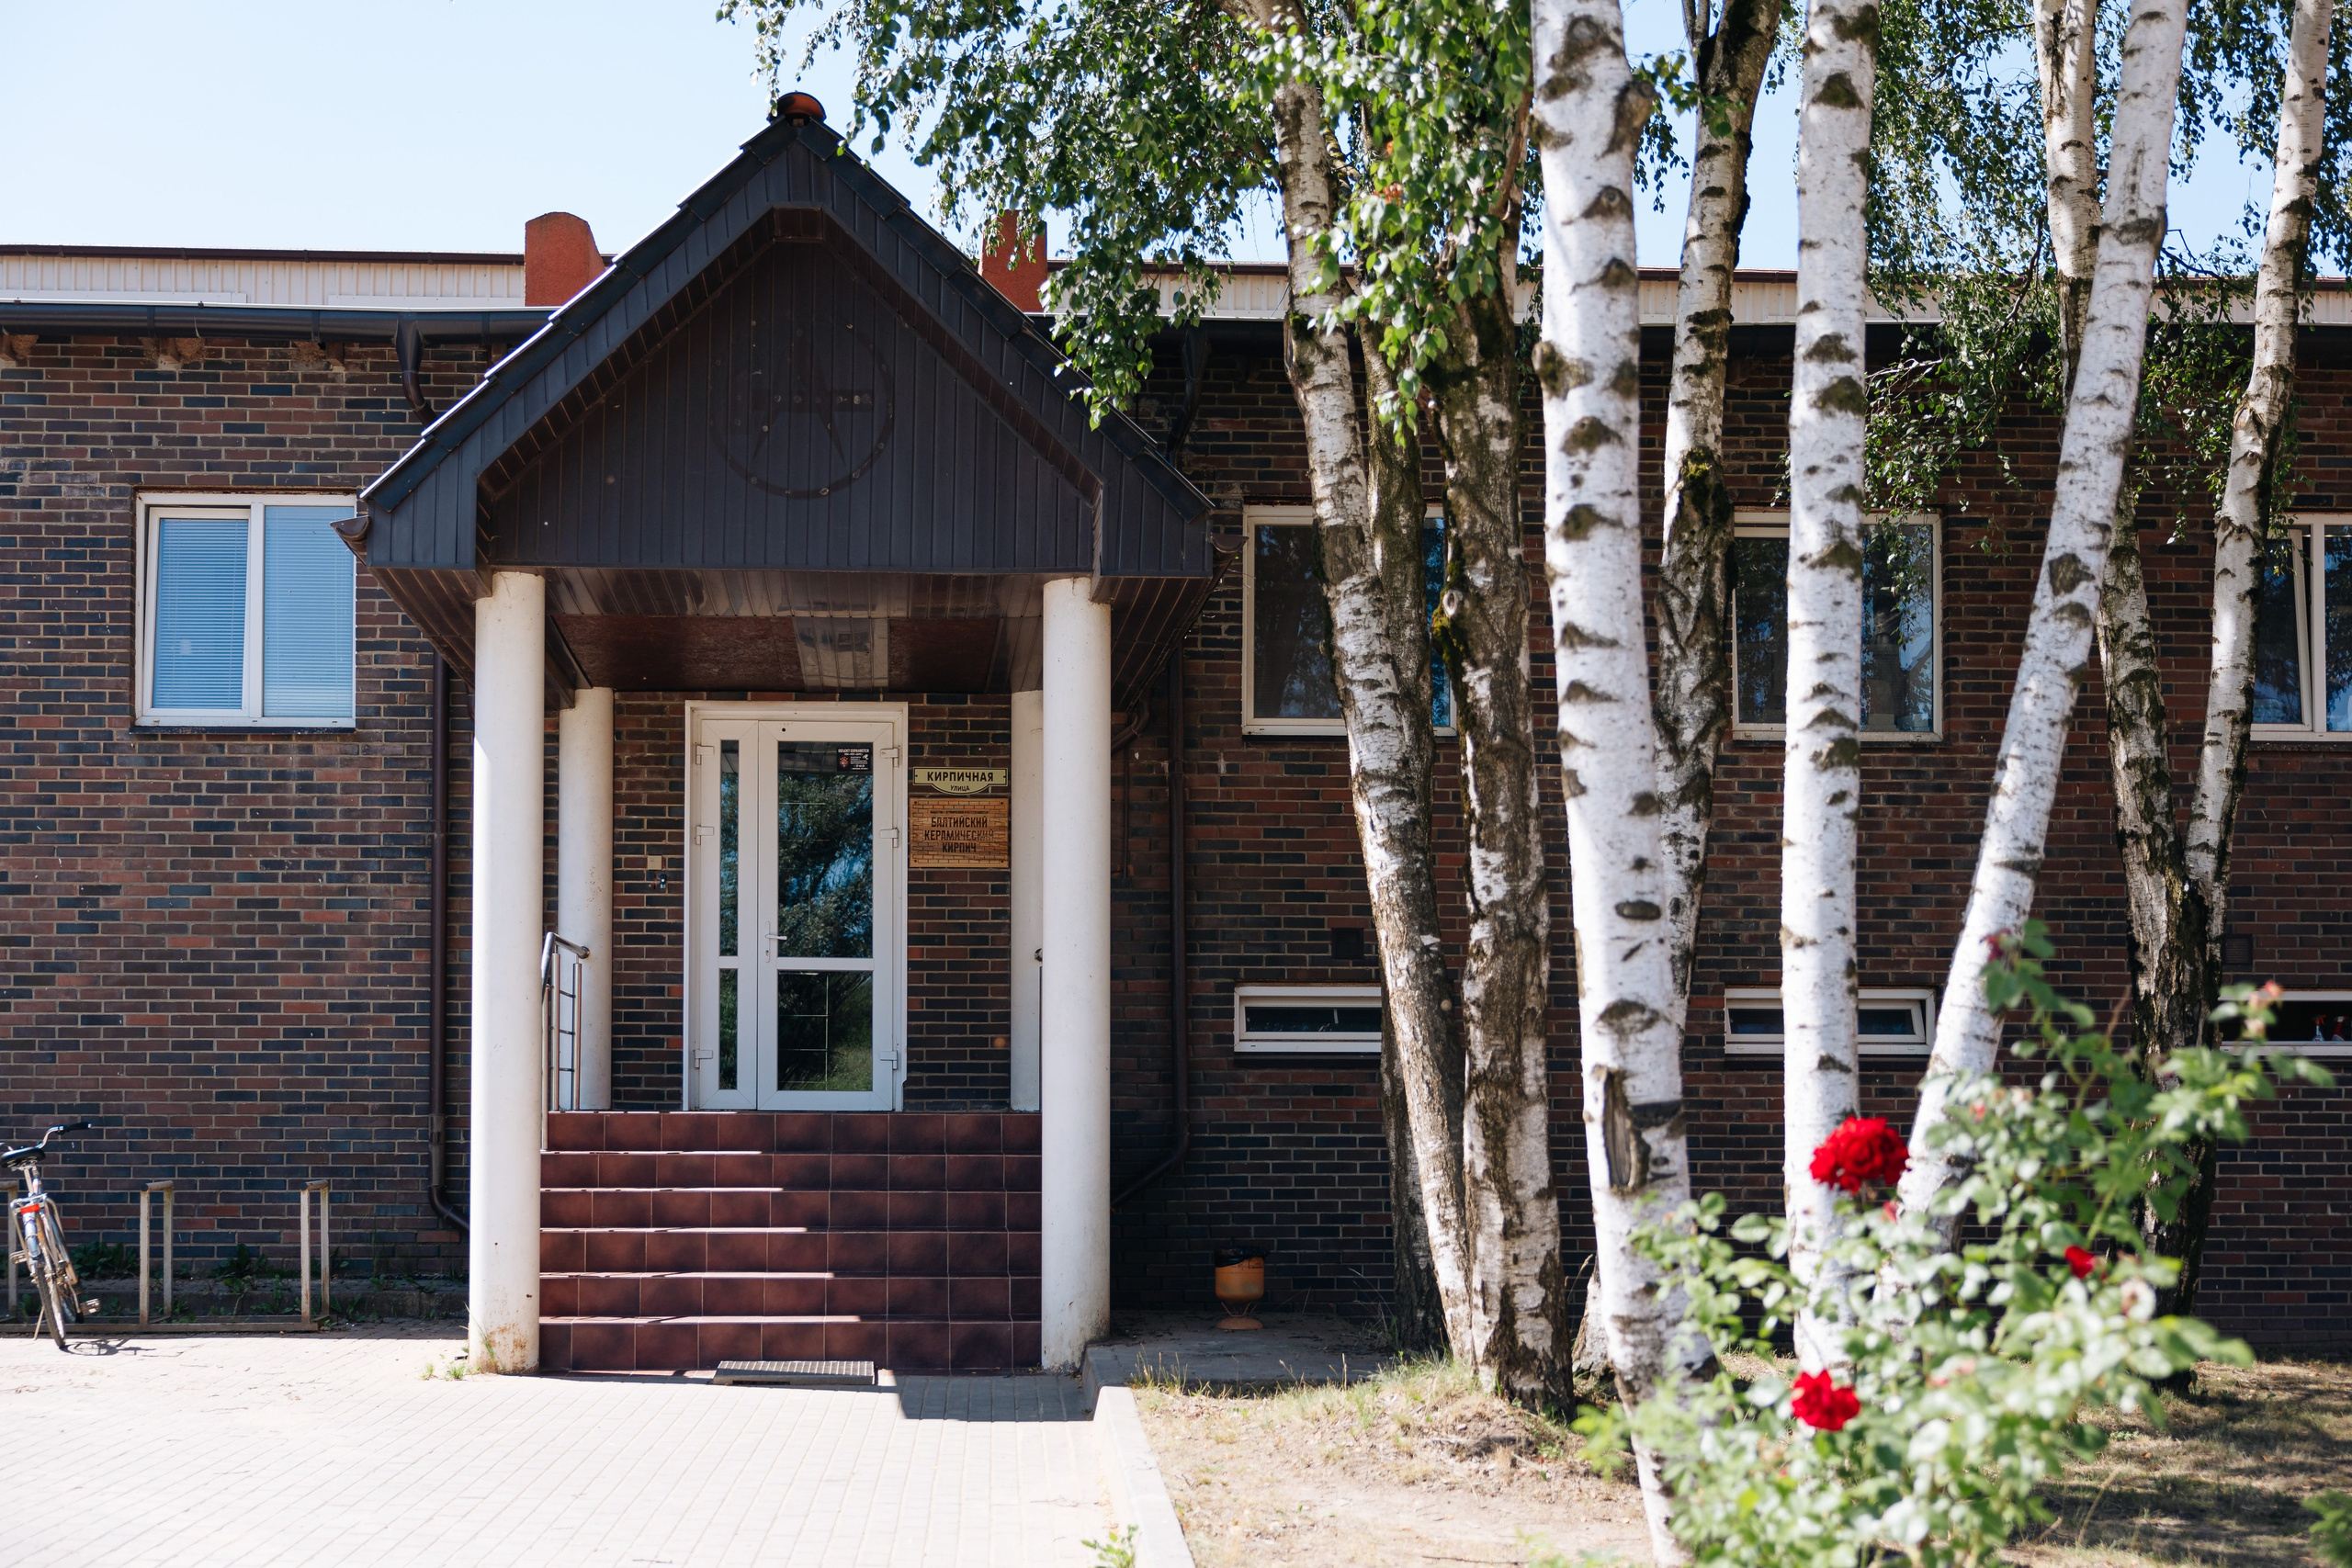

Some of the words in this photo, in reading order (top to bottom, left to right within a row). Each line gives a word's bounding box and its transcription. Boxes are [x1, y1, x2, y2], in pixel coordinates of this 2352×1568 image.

[927, 771, 994, 782] КИРПИЧНАЯ
[931, 816, 988, 828] БАЛТИЙСКИЙ
[924, 829, 994, 841] КЕРАМИЧЕСКИЙ
[942, 842, 977, 853] КИРПИЧ
